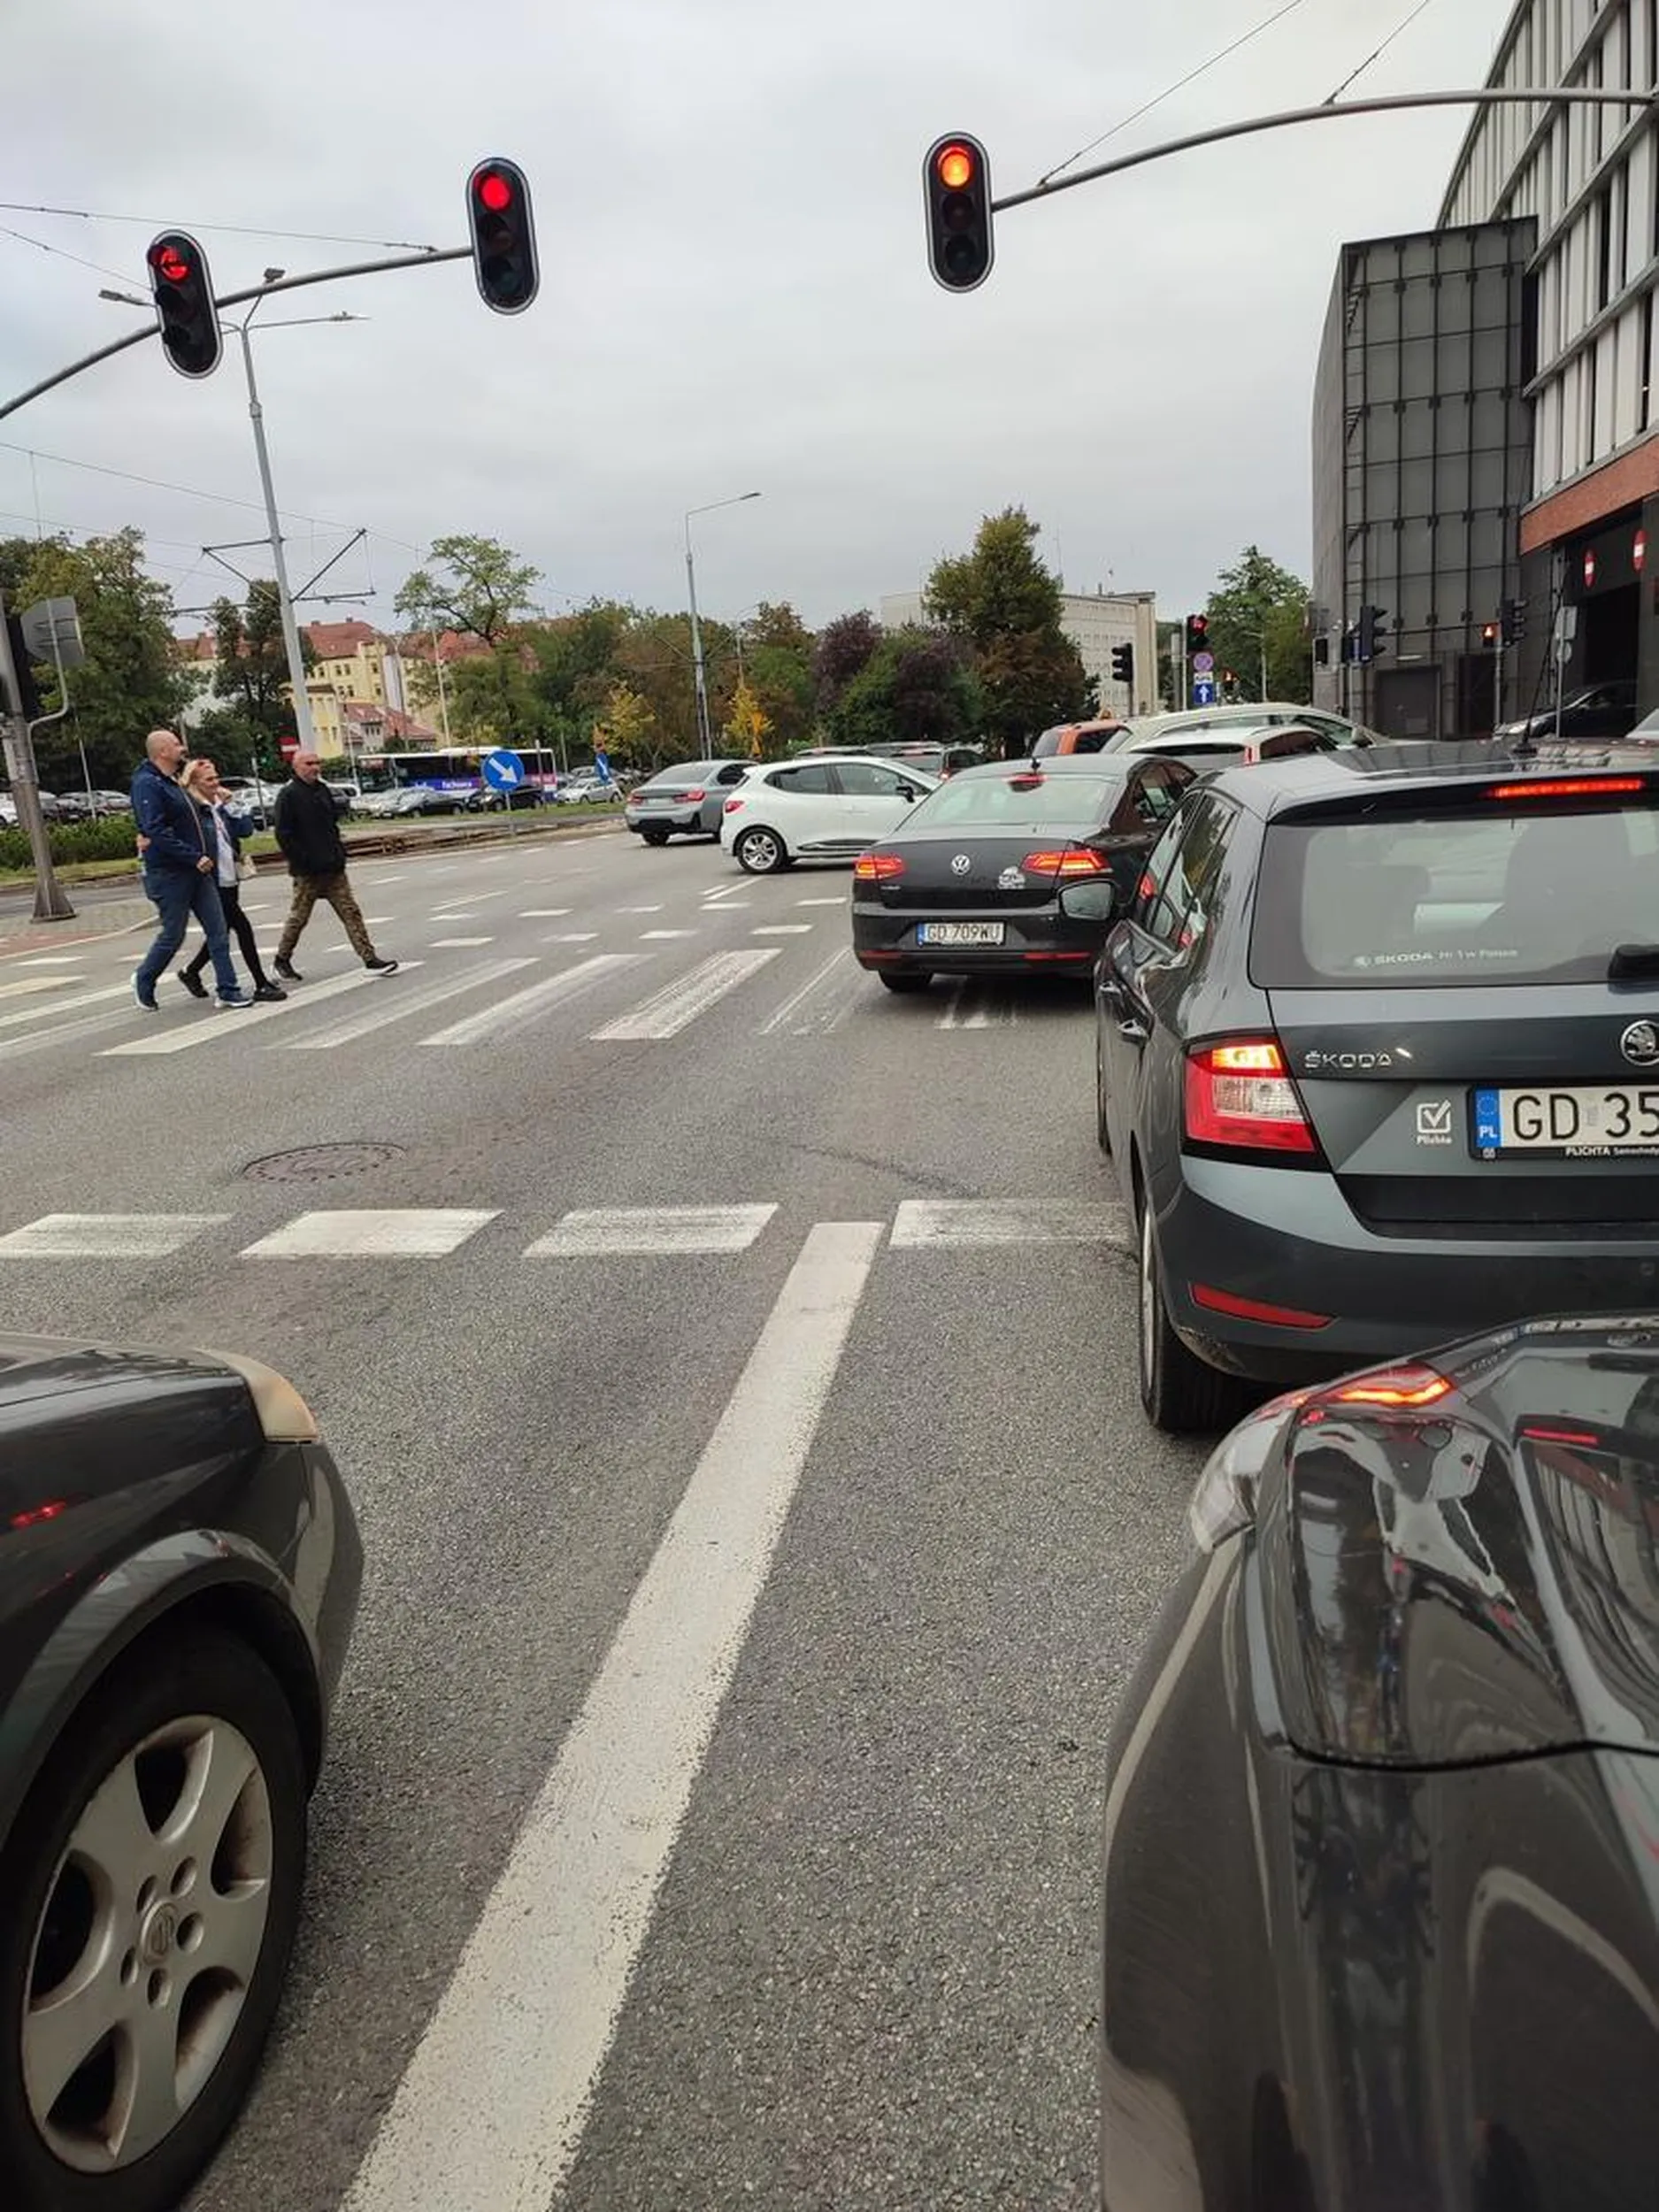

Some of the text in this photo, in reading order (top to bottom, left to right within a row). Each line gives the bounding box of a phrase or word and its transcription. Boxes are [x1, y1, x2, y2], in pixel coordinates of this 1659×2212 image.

[928, 925, 947, 940] GD
[1512, 1091, 1659, 1141] GD 35
[1479, 1125, 1498, 1139] PL
